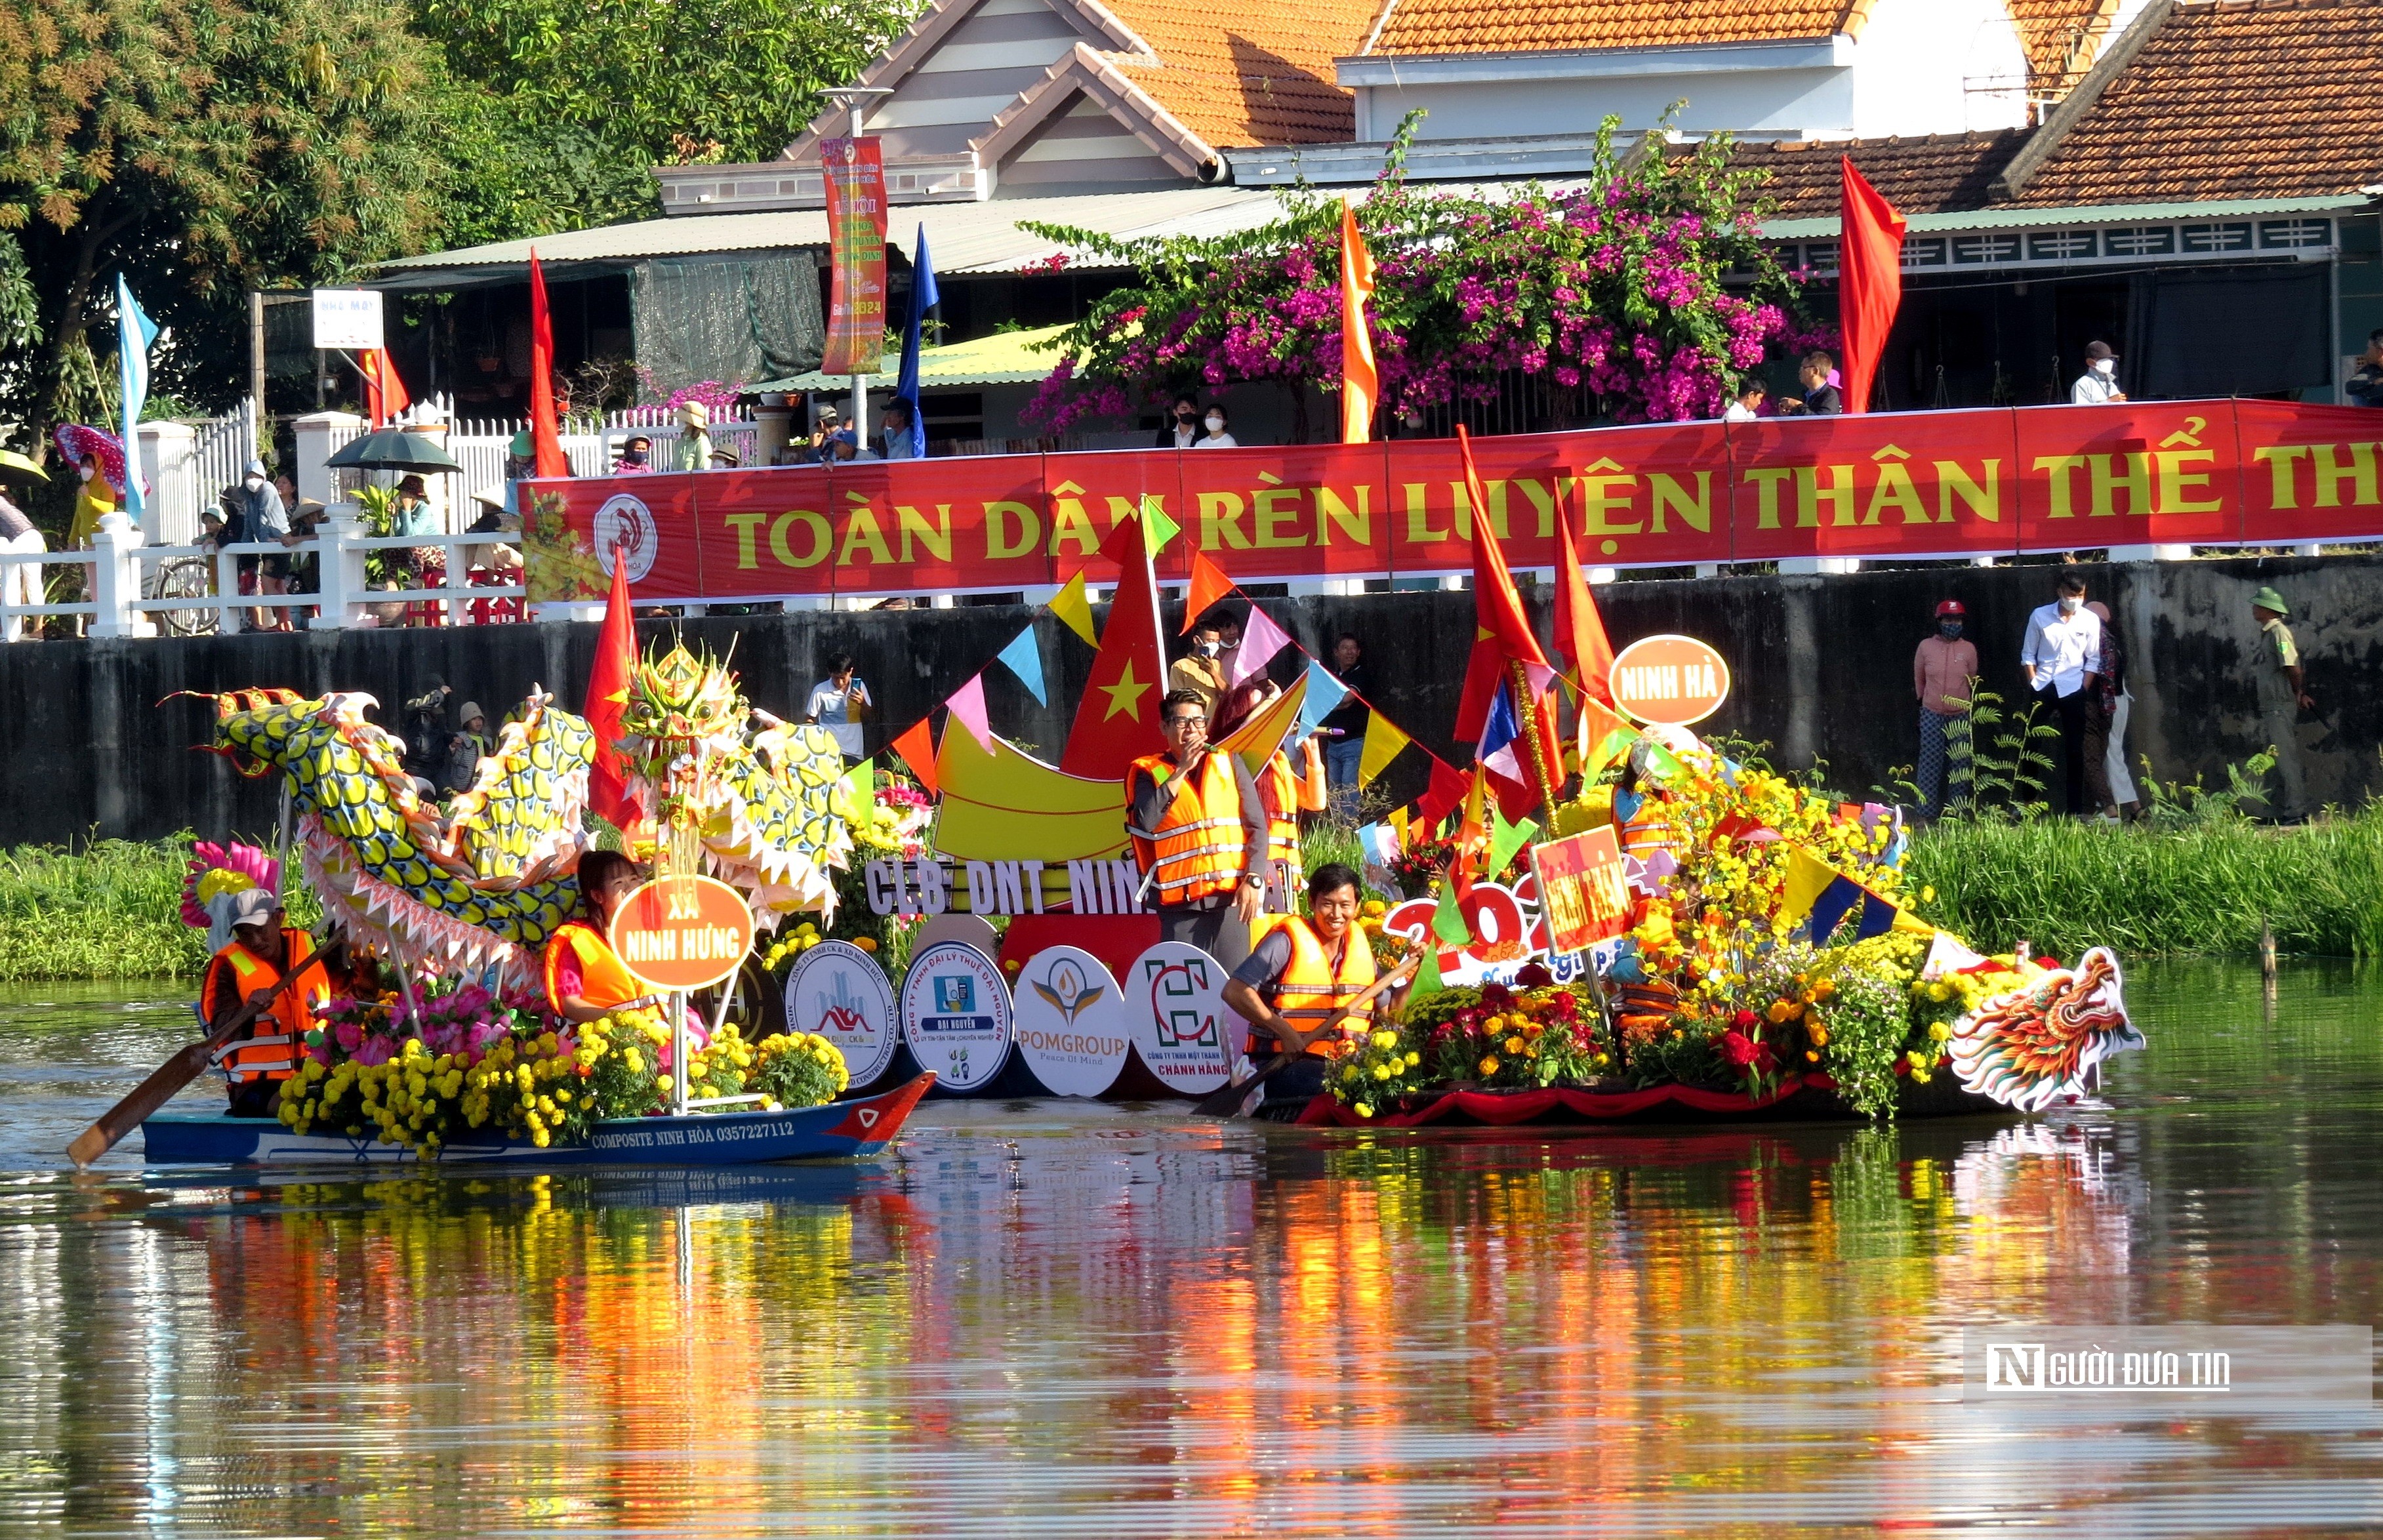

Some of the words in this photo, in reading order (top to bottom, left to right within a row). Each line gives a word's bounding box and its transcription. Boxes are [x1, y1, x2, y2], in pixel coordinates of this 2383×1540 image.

[853, 300, 882, 315] 2024
[724, 490, 953, 569] TOÀN
[1196, 470, 1371, 552] RÈN
[1402, 456, 1713, 556] LUYỆN
[1743, 443, 2002, 530] THÂN
[2033, 416, 2222, 519] THỂ
[2253, 441, 2383, 510] TH
[1620, 665, 1679, 701] NINH
[1684, 655, 1719, 699] HÀ
[865, 858, 947, 916] CLB
[966, 859, 1046, 916] DNT
[1067, 857, 1156, 916] NIN
[626, 929, 676, 963] NINH
[682, 921, 740, 961] HƯNG
[791, 962, 804, 983] CÔNG
[802, 954, 810, 964] TY
[853, 952, 871, 969] MINH
[928, 954, 945, 965] ĐẠI
[946, 951, 957, 961] LÝ
[959, 954, 983, 973] THUẾ
[912, 965, 929, 990] TNHH
[982, 971, 996, 992] ĐẠI
[909, 994, 916, 1007] TY
[787, 1004, 796, 1030] MINH
[909, 1012, 920, 1043] CÔNG
[950, 1016, 976, 1030] NGUYÊN
[1019, 1030, 1125, 1057] POMGROUP
[1147, 1050, 1164, 1060] CÔNG
[1164, 1051, 1171, 1060] TY
[1187, 1050, 1201, 1061] MỘT
[856, 1042, 893, 1084] CONSTRUCTION
[1040, 1052, 1065, 1062] Peace
[1080, 1055, 1103, 1065] Mind
[1158, 1063, 1196, 1076] CHÁNH
[591, 1130, 655, 1150] COMPOSITE
[656, 1129, 684, 1146] NINH
[687, 1124, 715, 1144] HÒA
[716, 1121, 795, 1143] 0357227112
